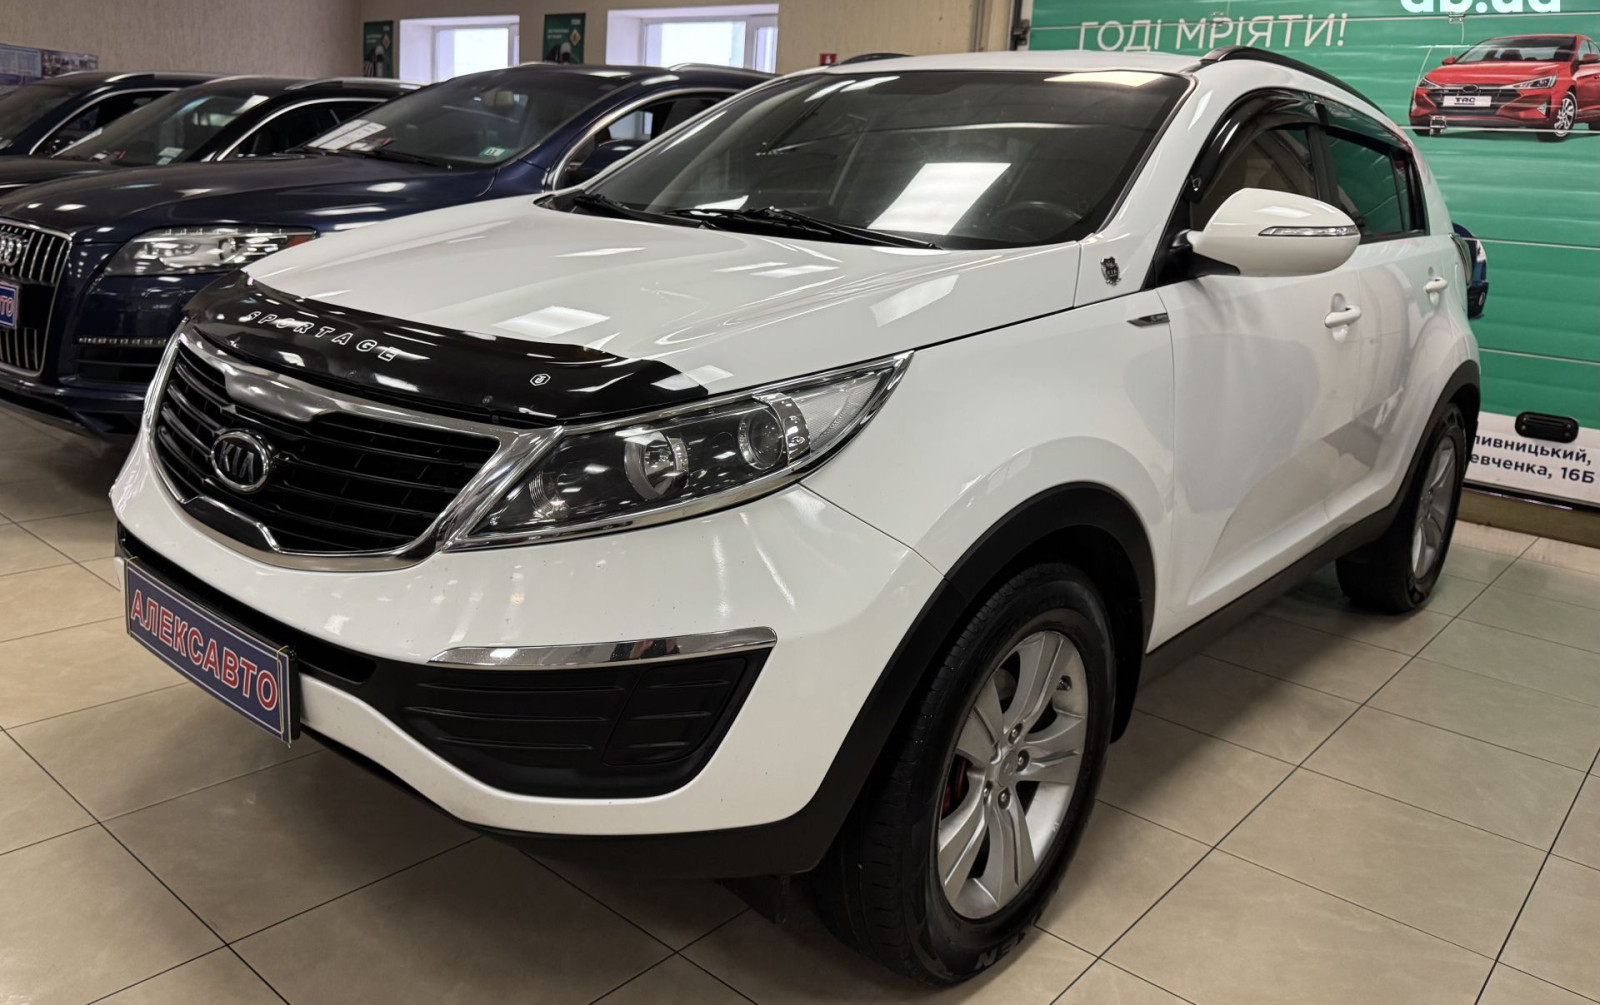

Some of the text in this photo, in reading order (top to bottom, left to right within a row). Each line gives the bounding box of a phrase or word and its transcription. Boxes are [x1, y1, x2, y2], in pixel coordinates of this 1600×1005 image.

[1079, 12, 1348, 52] ГОДІ МРІЯТИ!
[238, 310, 398, 362] SPORTAGE
[1560, 466, 1596, 484] 16Б
[130, 589, 278, 711] АЛЕКСАВТО
